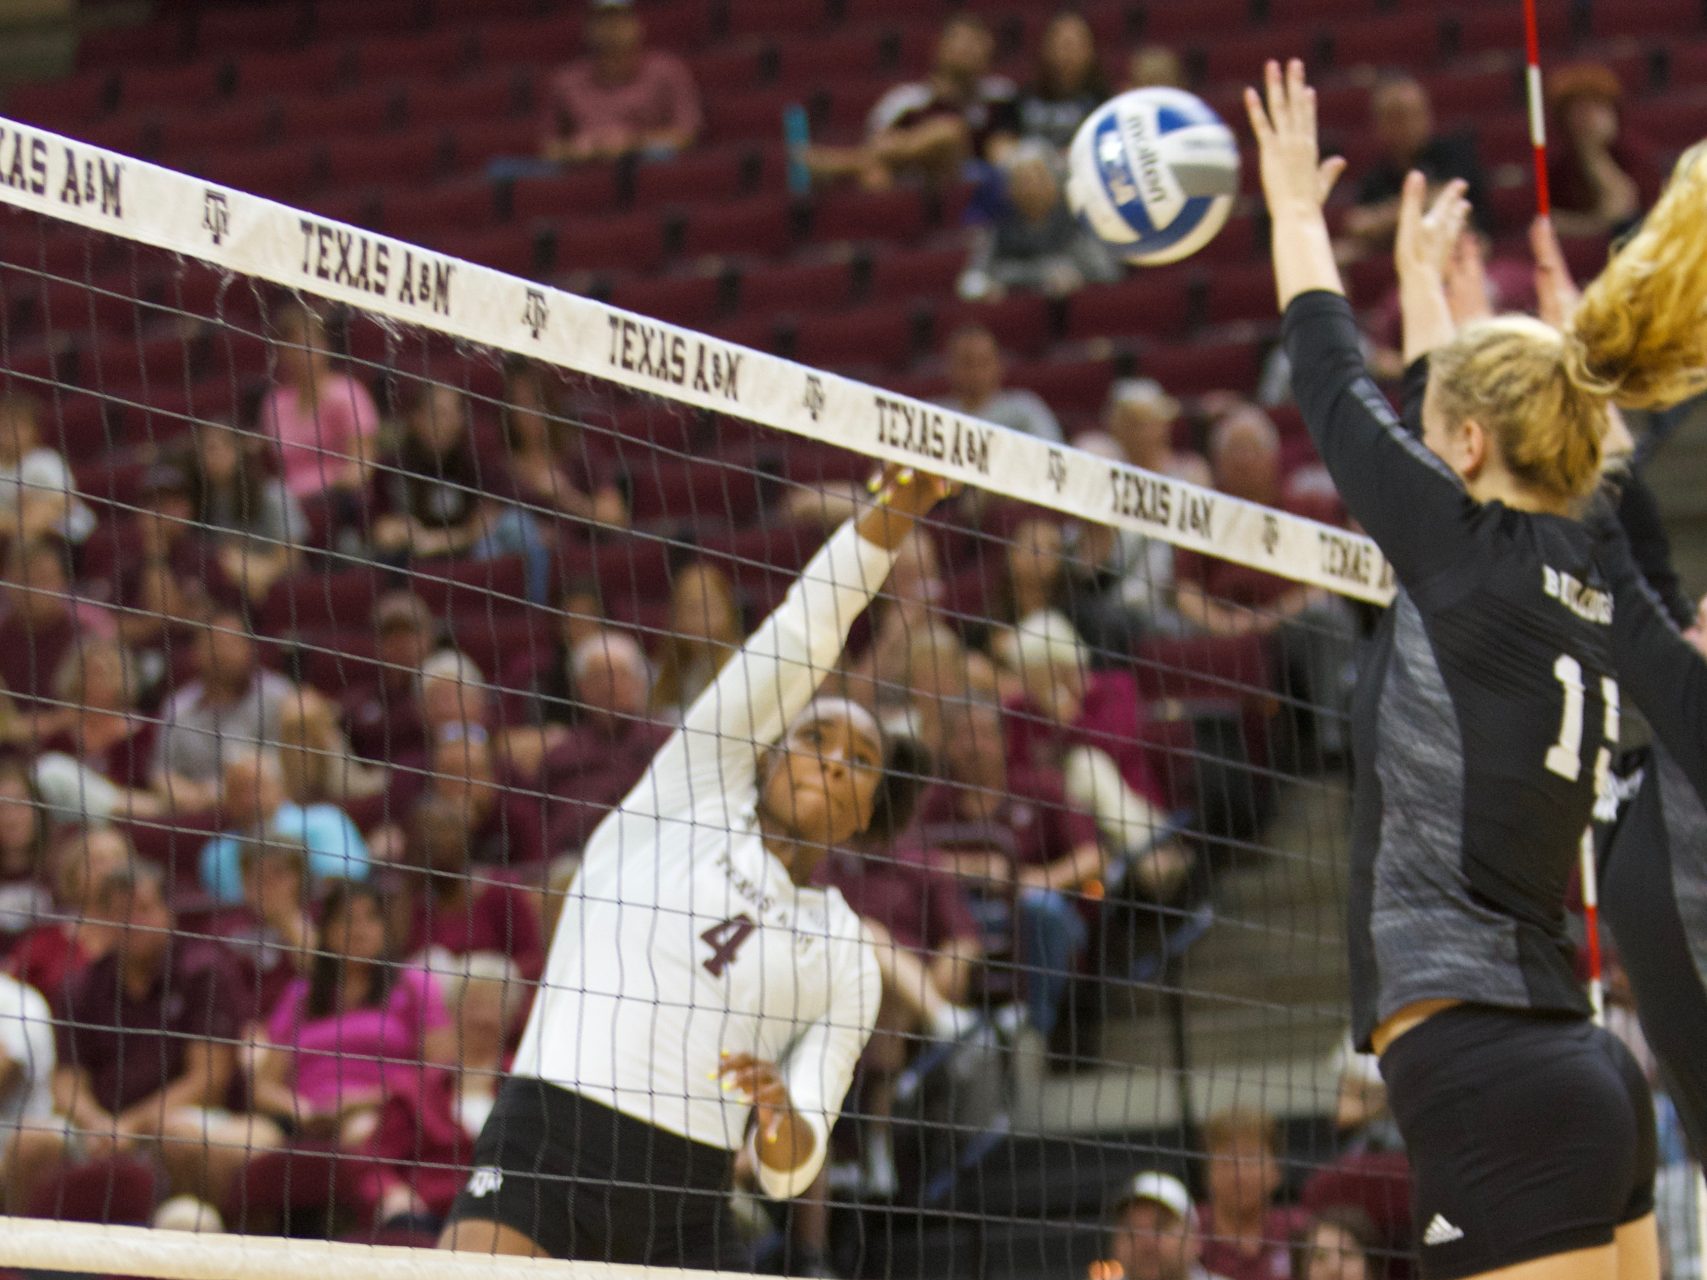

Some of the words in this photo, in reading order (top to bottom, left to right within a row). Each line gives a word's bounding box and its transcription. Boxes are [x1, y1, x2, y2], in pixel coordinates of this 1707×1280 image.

[0, 126, 48, 196] AS
[61, 146, 123, 219] A&M
[299, 217, 390, 297] TEXAS
[398, 248, 453, 317] A&M
[607, 314, 687, 387] TEXAS
[692, 341, 742, 403] A&M
[873, 396, 945, 462] TEXAS
[699, 911, 757, 981] 4
